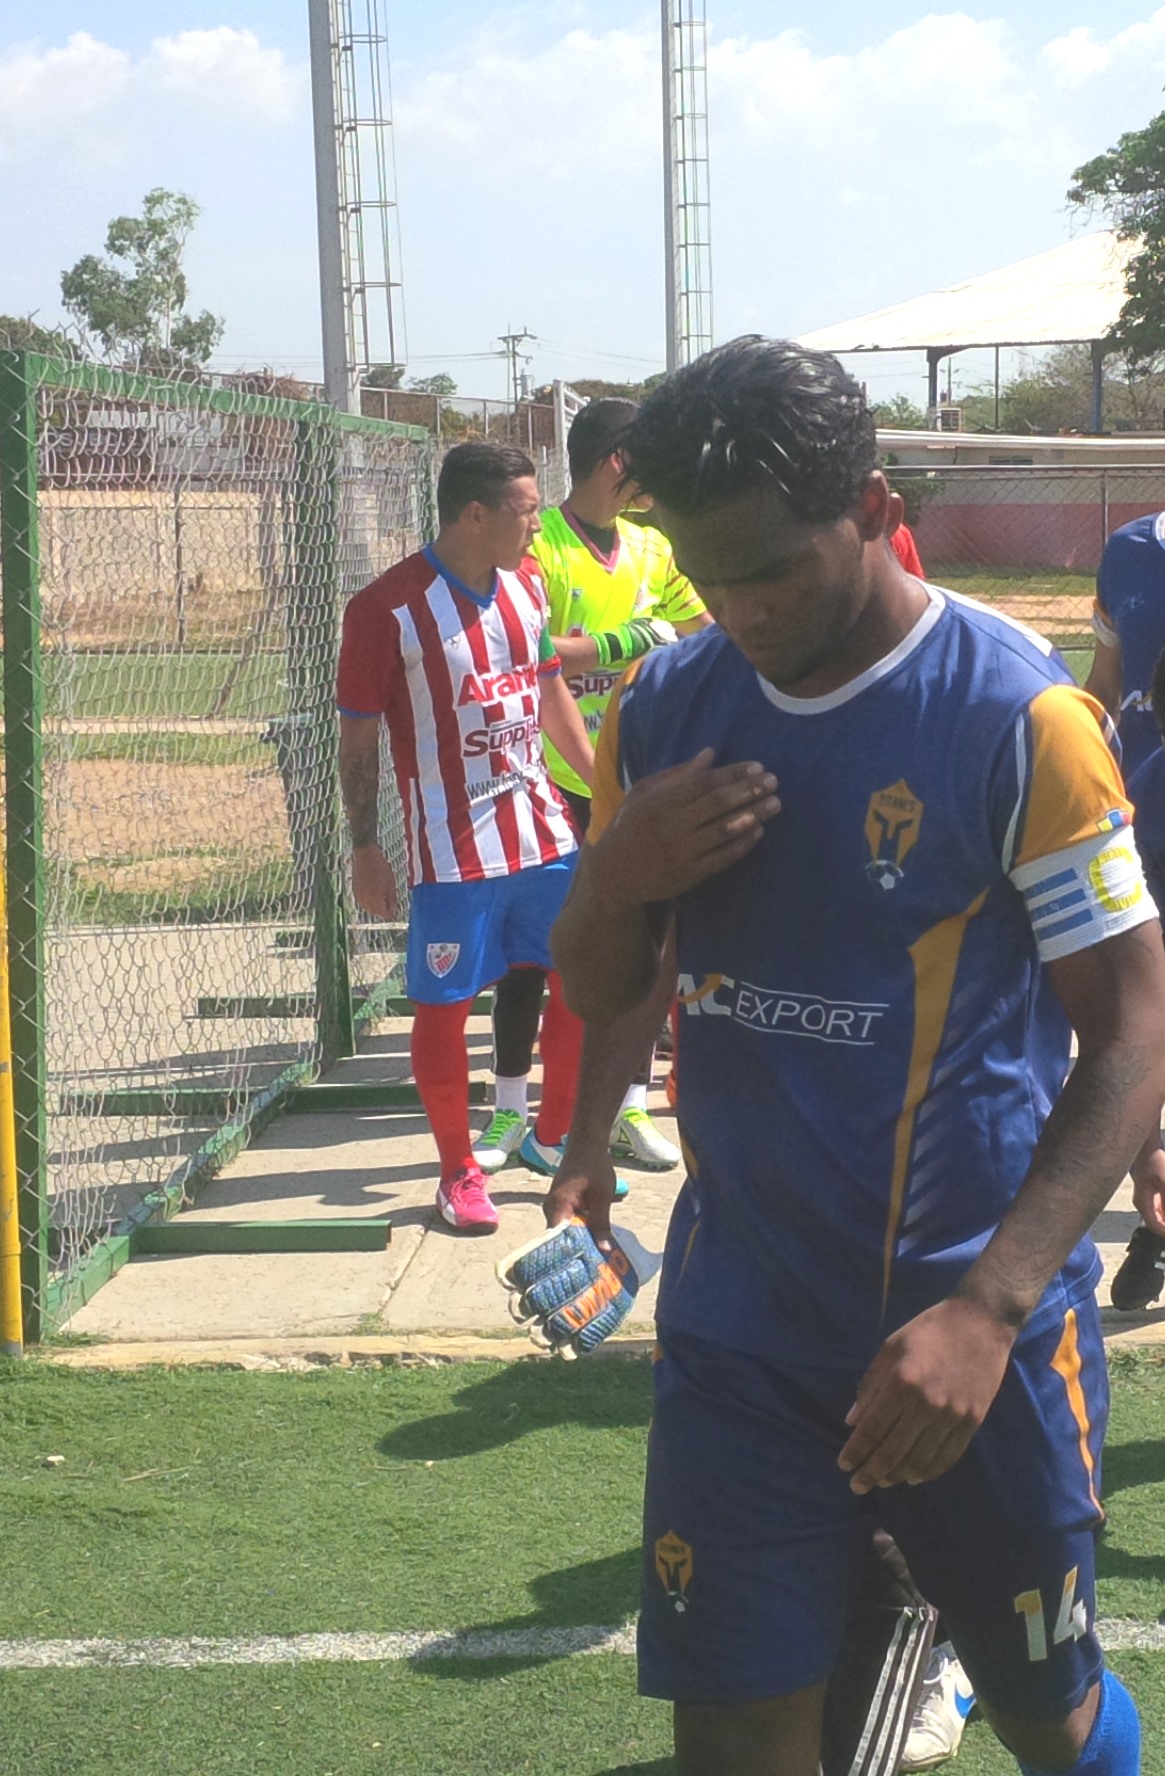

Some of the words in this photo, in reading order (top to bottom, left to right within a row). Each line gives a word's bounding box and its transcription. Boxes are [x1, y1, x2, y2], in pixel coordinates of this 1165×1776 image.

[877, 793, 915, 812] TITANES
[1088, 846, 1143, 914] C
[736, 989, 884, 1038] EXPORT
[1013, 1564, 1088, 1662] 14
